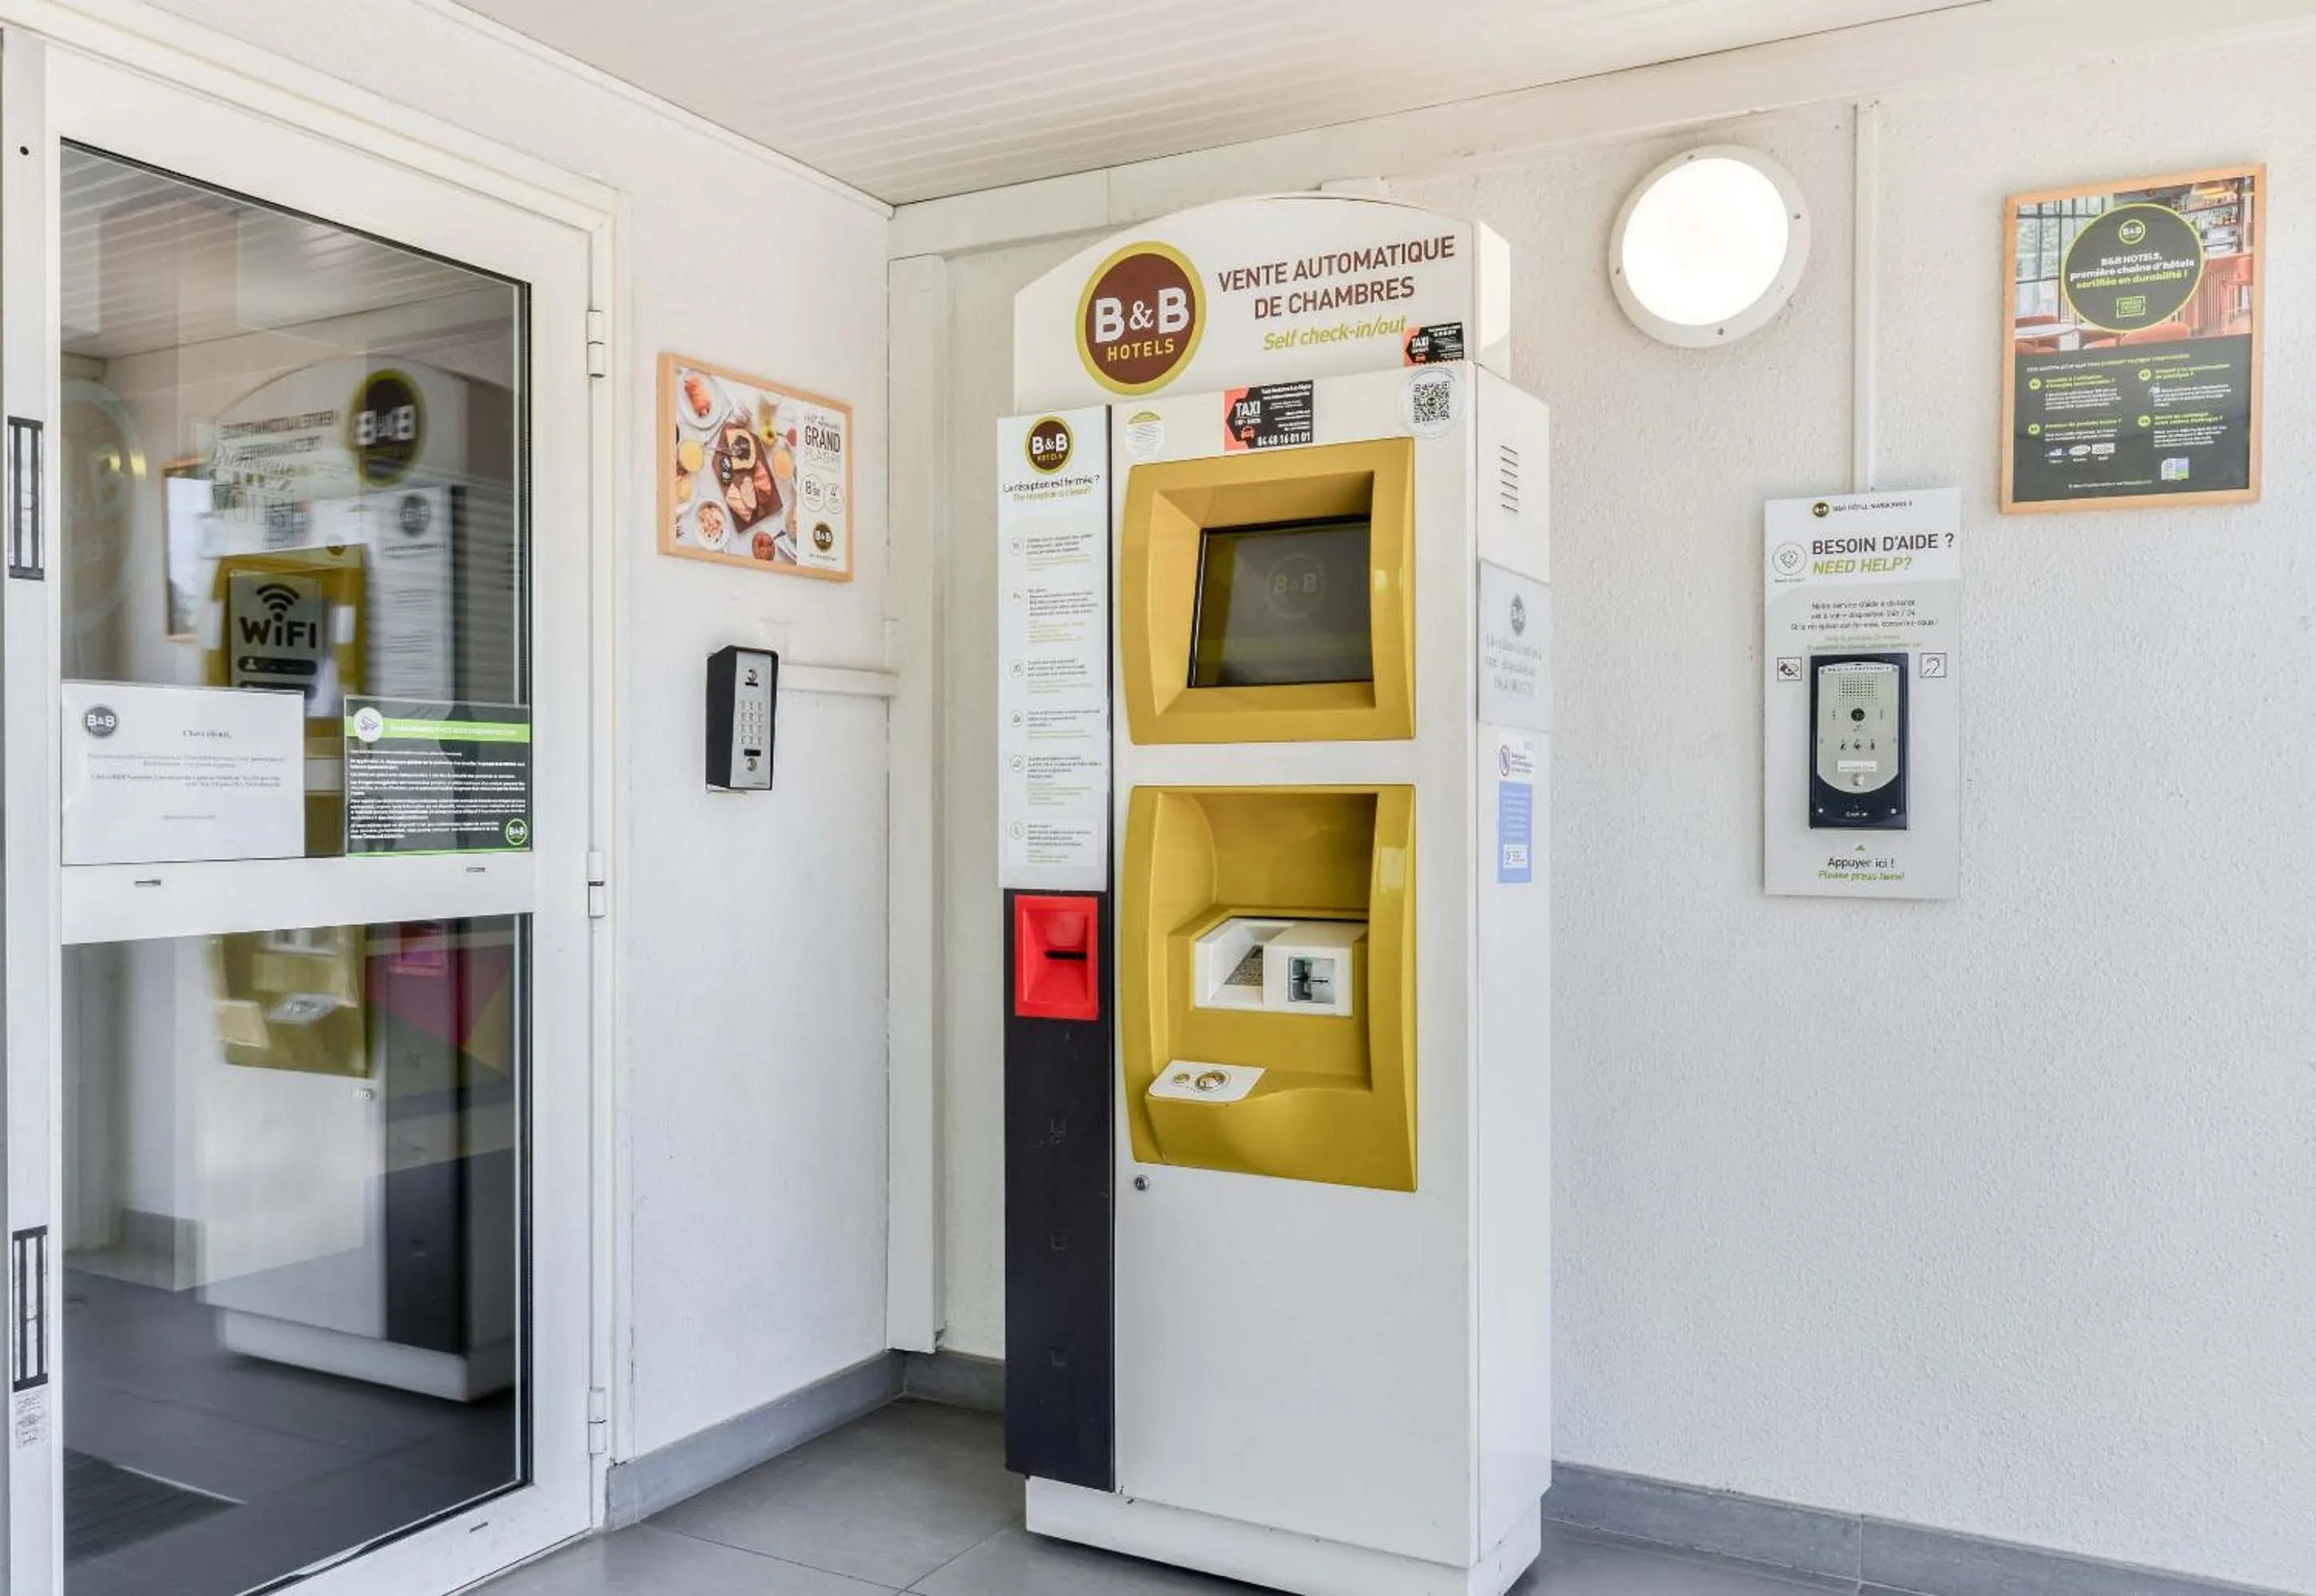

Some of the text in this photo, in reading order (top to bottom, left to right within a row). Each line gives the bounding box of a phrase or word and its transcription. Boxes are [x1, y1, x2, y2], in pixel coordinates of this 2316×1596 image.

[1218, 235, 1456, 292] VENTE AUTOMATIQUE
[1255, 275, 1415, 320] DE CHAMBRES
[1093, 287, 1190, 344] B&B
[1263, 330, 1297, 351] Self
[1299, 316, 1406, 347] check-in/out
[1411, 336, 1429, 348] TAXI
[1107, 338, 1175, 362] HOTELS
[1235, 401, 1260, 417] TAXI
[805, 426, 841, 453] GRAND
[1032, 433, 1068, 454] B&B
[1301, 432, 1310, 442] 01
[1811, 533, 1954, 556] BESOIN D'AIDE ?
[1813, 556, 1912, 575] NEED HELP?
[87, 714, 115, 727] B&B
[1827, 857, 1871, 869] Appuyer
[1875, 857, 1888, 868] ici
